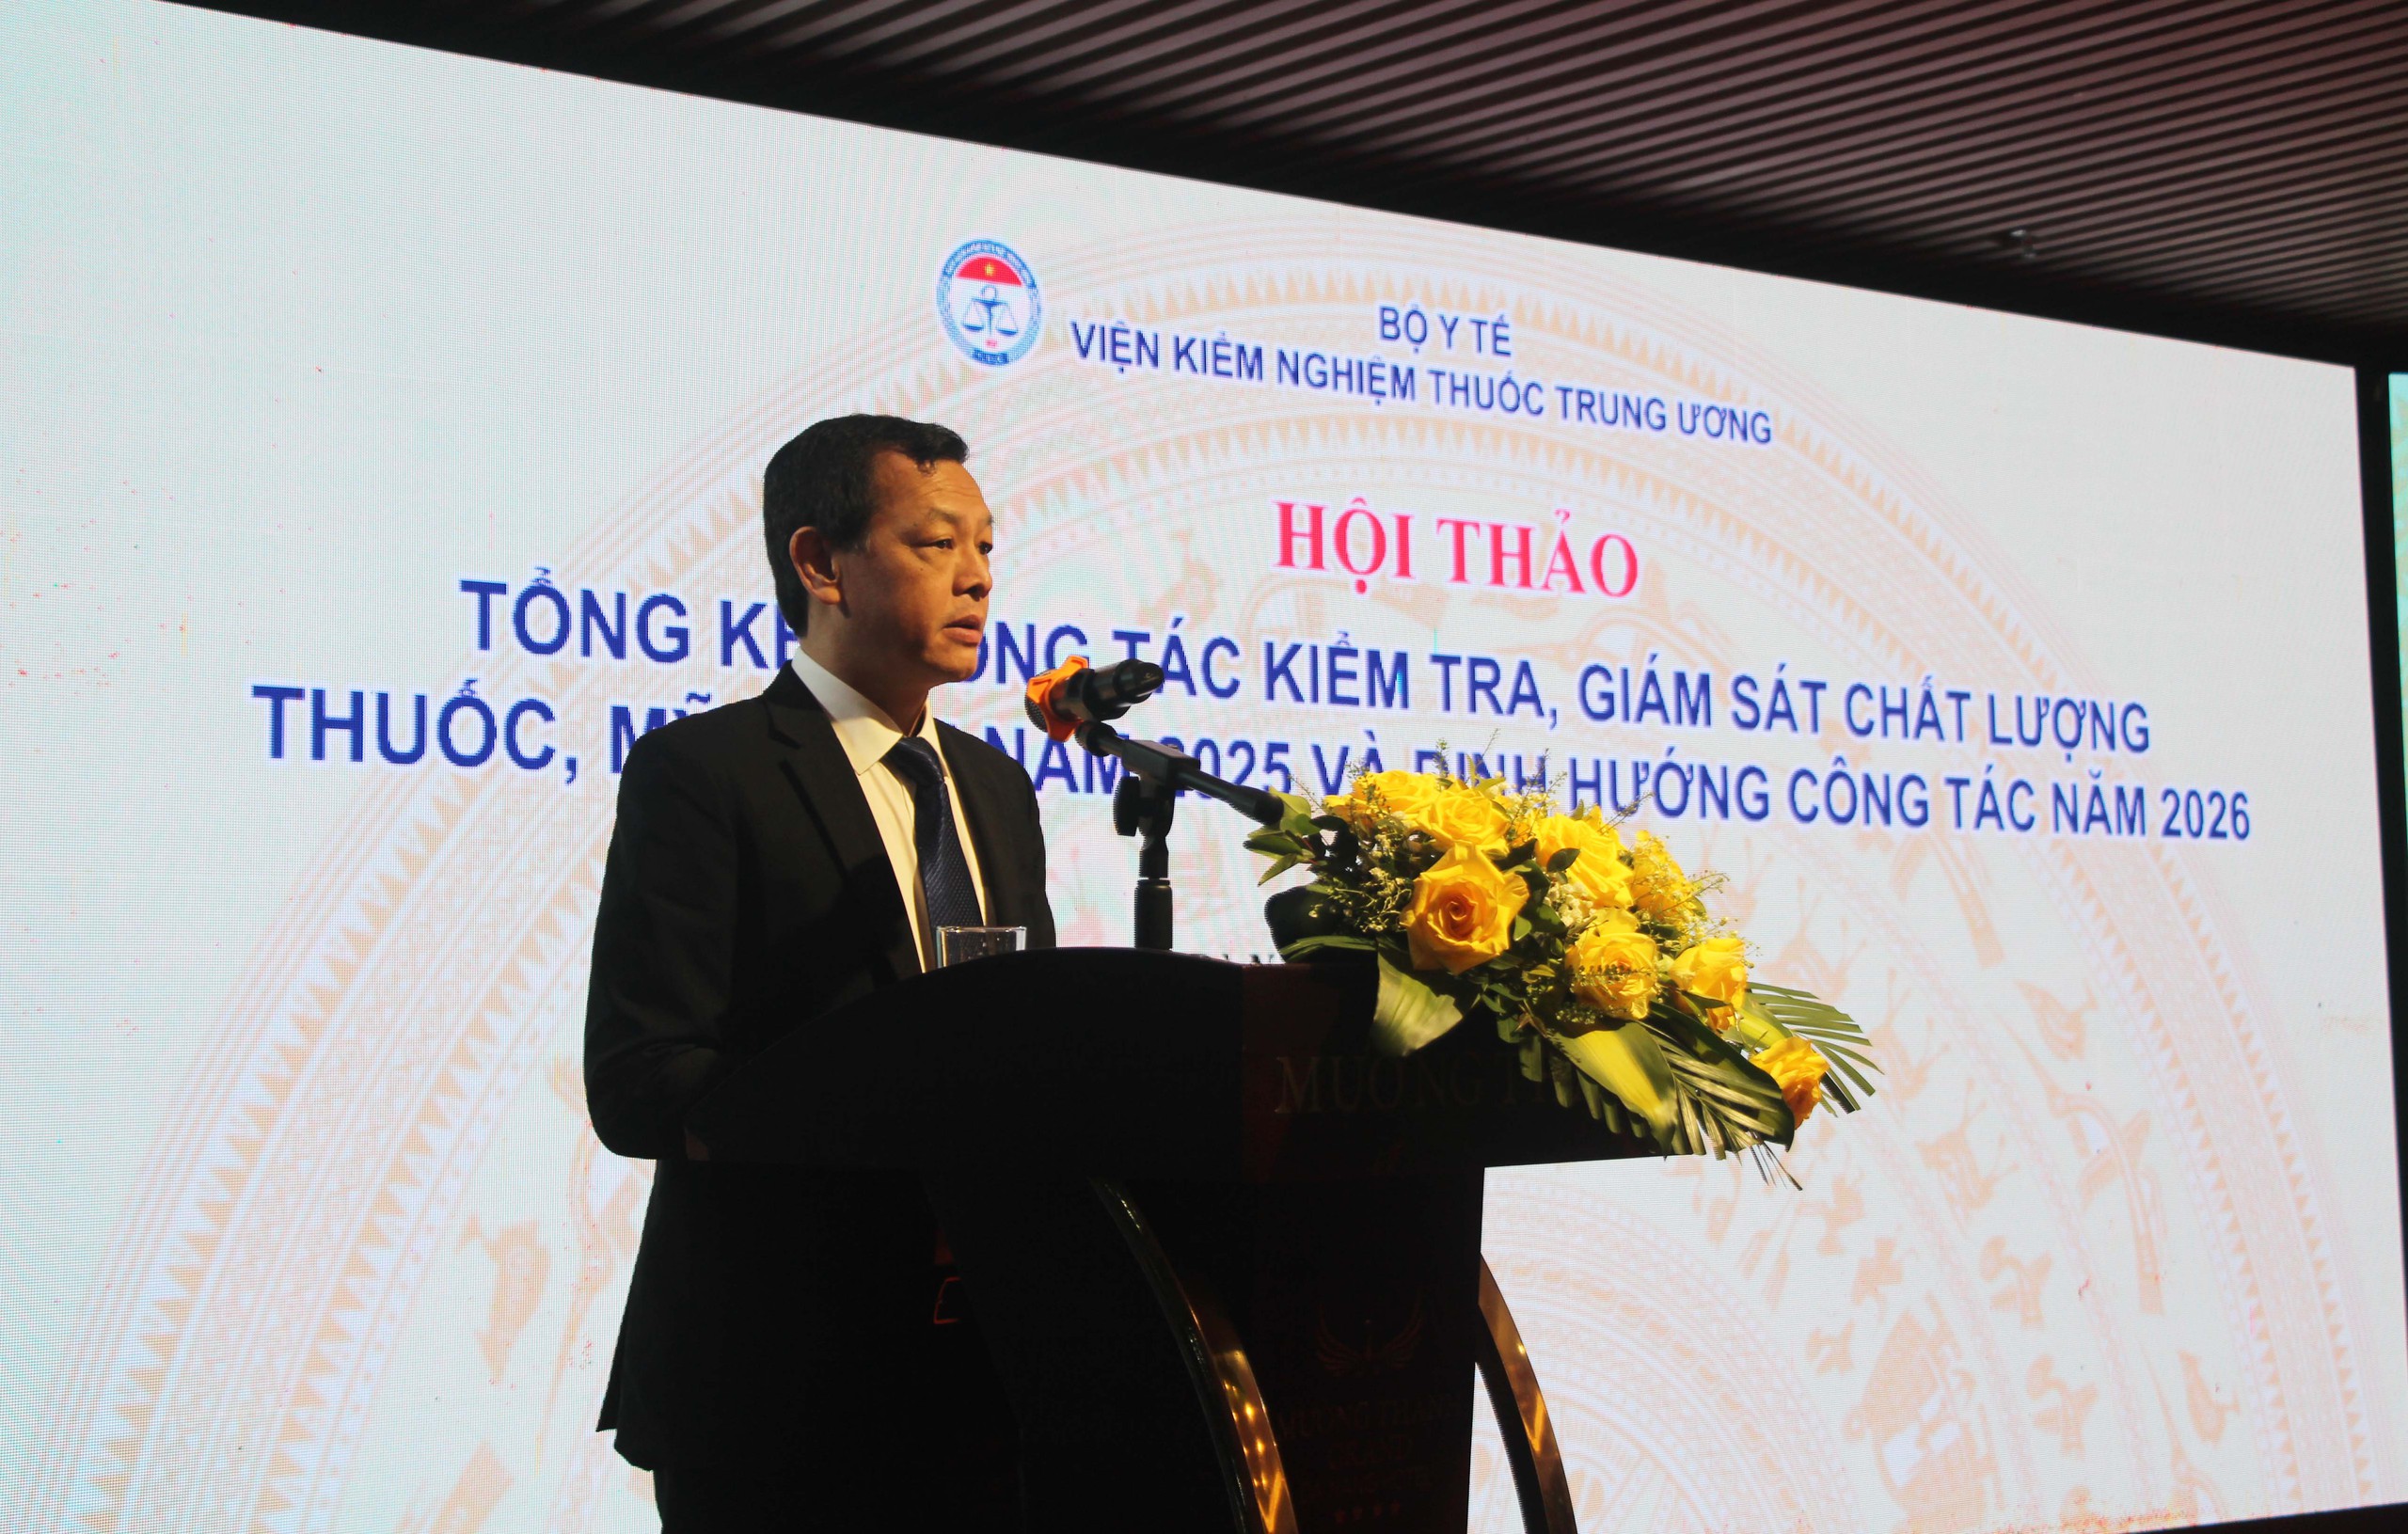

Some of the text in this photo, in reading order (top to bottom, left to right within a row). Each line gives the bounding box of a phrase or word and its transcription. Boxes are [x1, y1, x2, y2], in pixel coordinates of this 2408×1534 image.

[1071, 322, 1771, 444] VIỆN KIỂM NGHIỆM THUỐC TRUNG ƯƠNG
[1378, 303, 1511, 356] BỘ Y TẾ
[1277, 497, 1640, 597] HỘI THẢO
[460, 567, 689, 663] TỔNG
[1113, 617, 1240, 699] TÁC
[1265, 632, 1409, 708] KIỂM
[1430, 654, 1557, 728] TRA,
[1579, 654, 1711, 726] GIÁM
[1733, 663, 1827, 733] SÁT
[1846, 676, 1971, 741] CHẤT
[1988, 694, 2149, 762] LƯỢNG
[251, 678, 577, 784] THUỐC,
[1571, 746, 1769, 821] HƯỚNG
[1789, 756, 1929, 828] CÔNG
[1945, 765, 2036, 831] TÁC
[2053, 771, 2146, 835] NĂM
[2162, 788, 2250, 840] 2026
